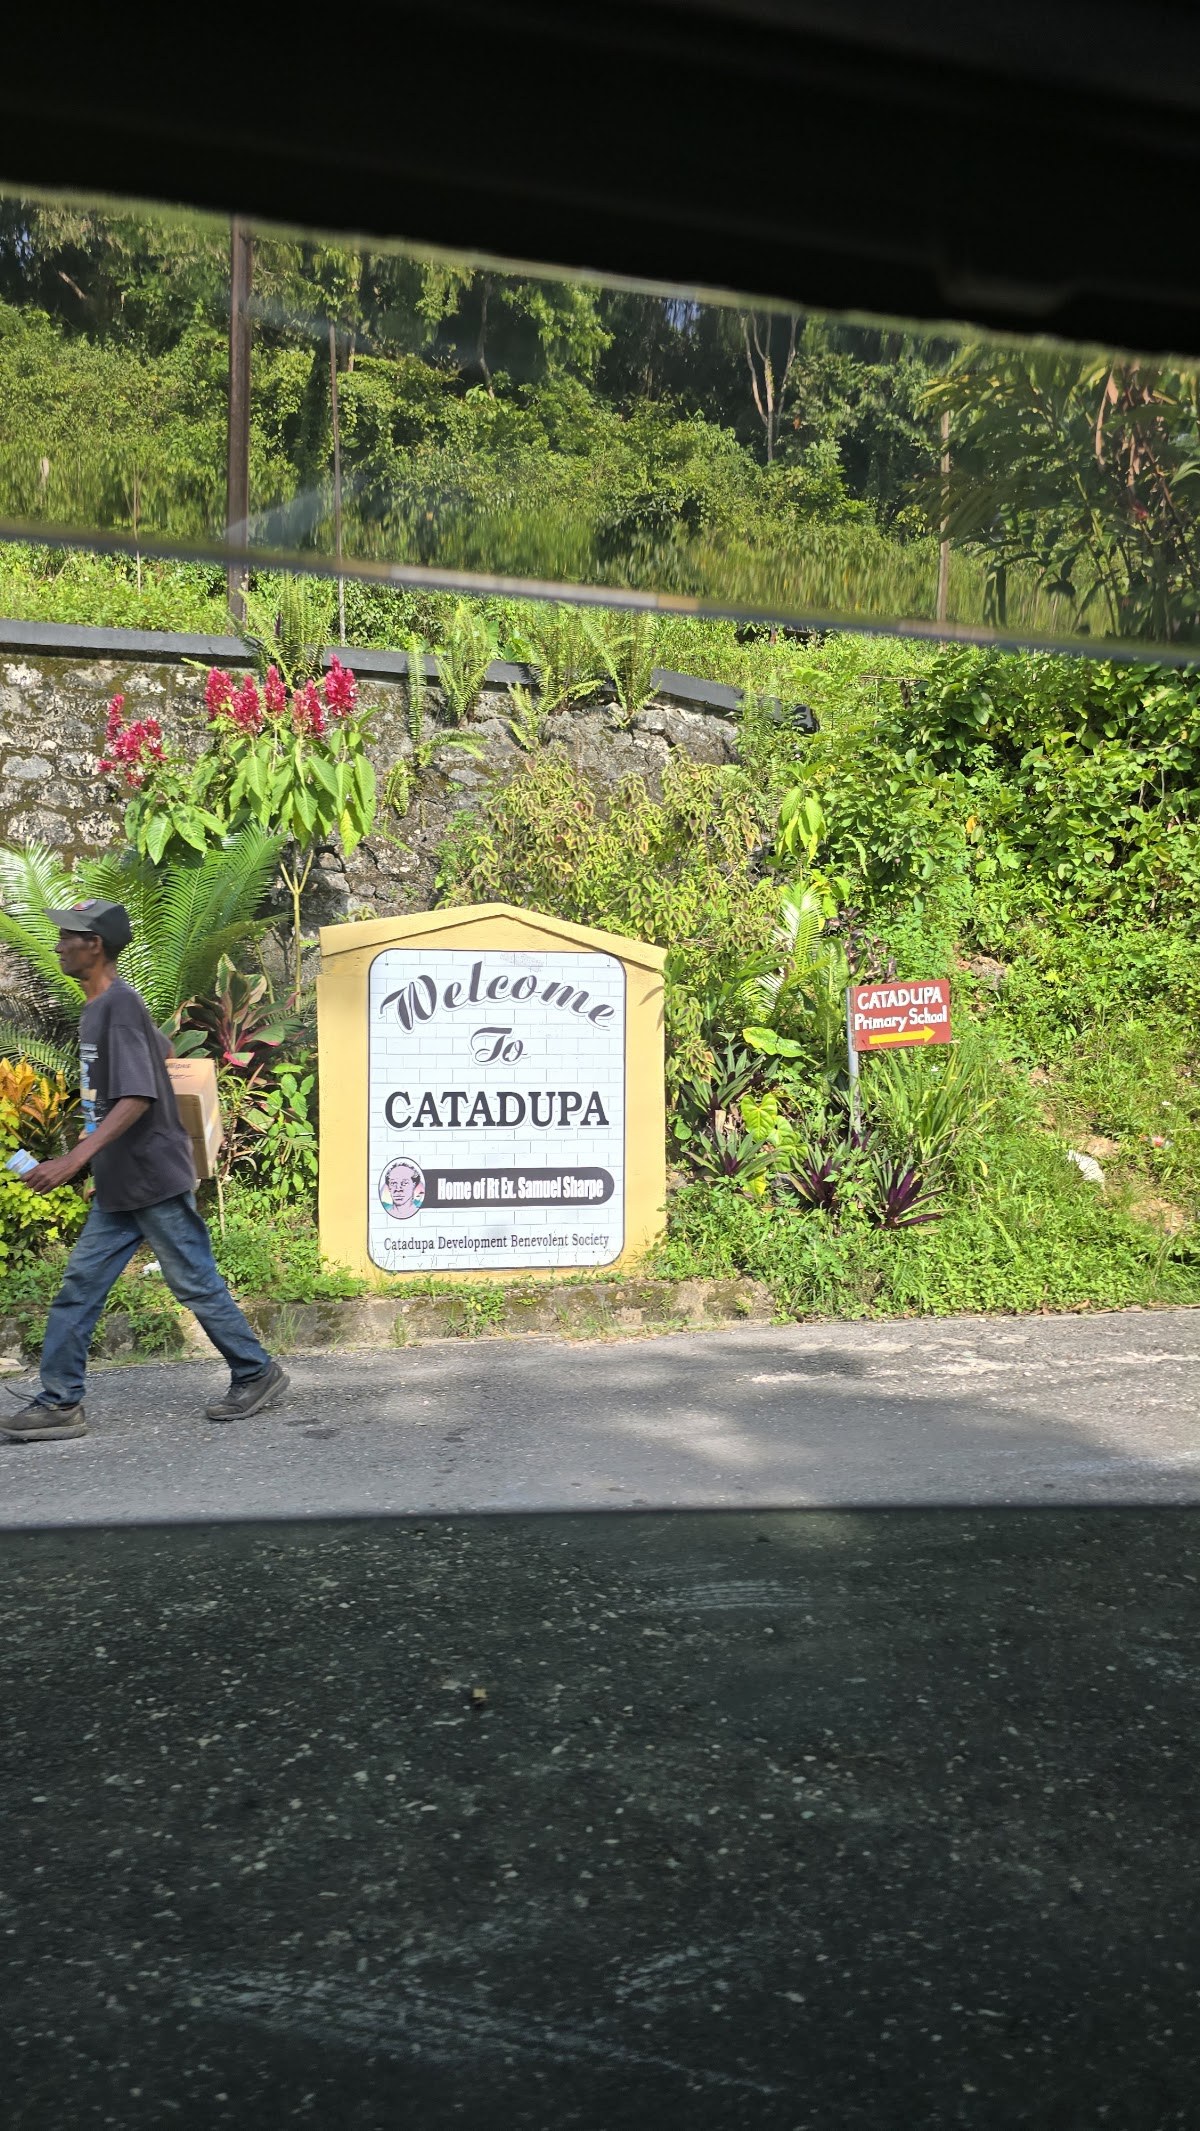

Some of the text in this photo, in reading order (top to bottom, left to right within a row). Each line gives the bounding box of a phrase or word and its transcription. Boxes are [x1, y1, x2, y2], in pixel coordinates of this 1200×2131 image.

[380, 961, 615, 1030] Welcome
[857, 986, 943, 1010] CATADUPA
[854, 1005, 947, 1032] Primary School
[470, 1027, 528, 1063] To
[385, 1091, 610, 1129] CATADUPA
[437, 1178, 471, 1200] Home
[473, 1178, 486, 1200] of
[487, 1177, 500, 1199] Rt
[518, 1176, 562, 1199] Samuel
[563, 1175, 604, 1200] Sharpe
[384, 1233, 609, 1253] Catadupa Development Benevolent Society
